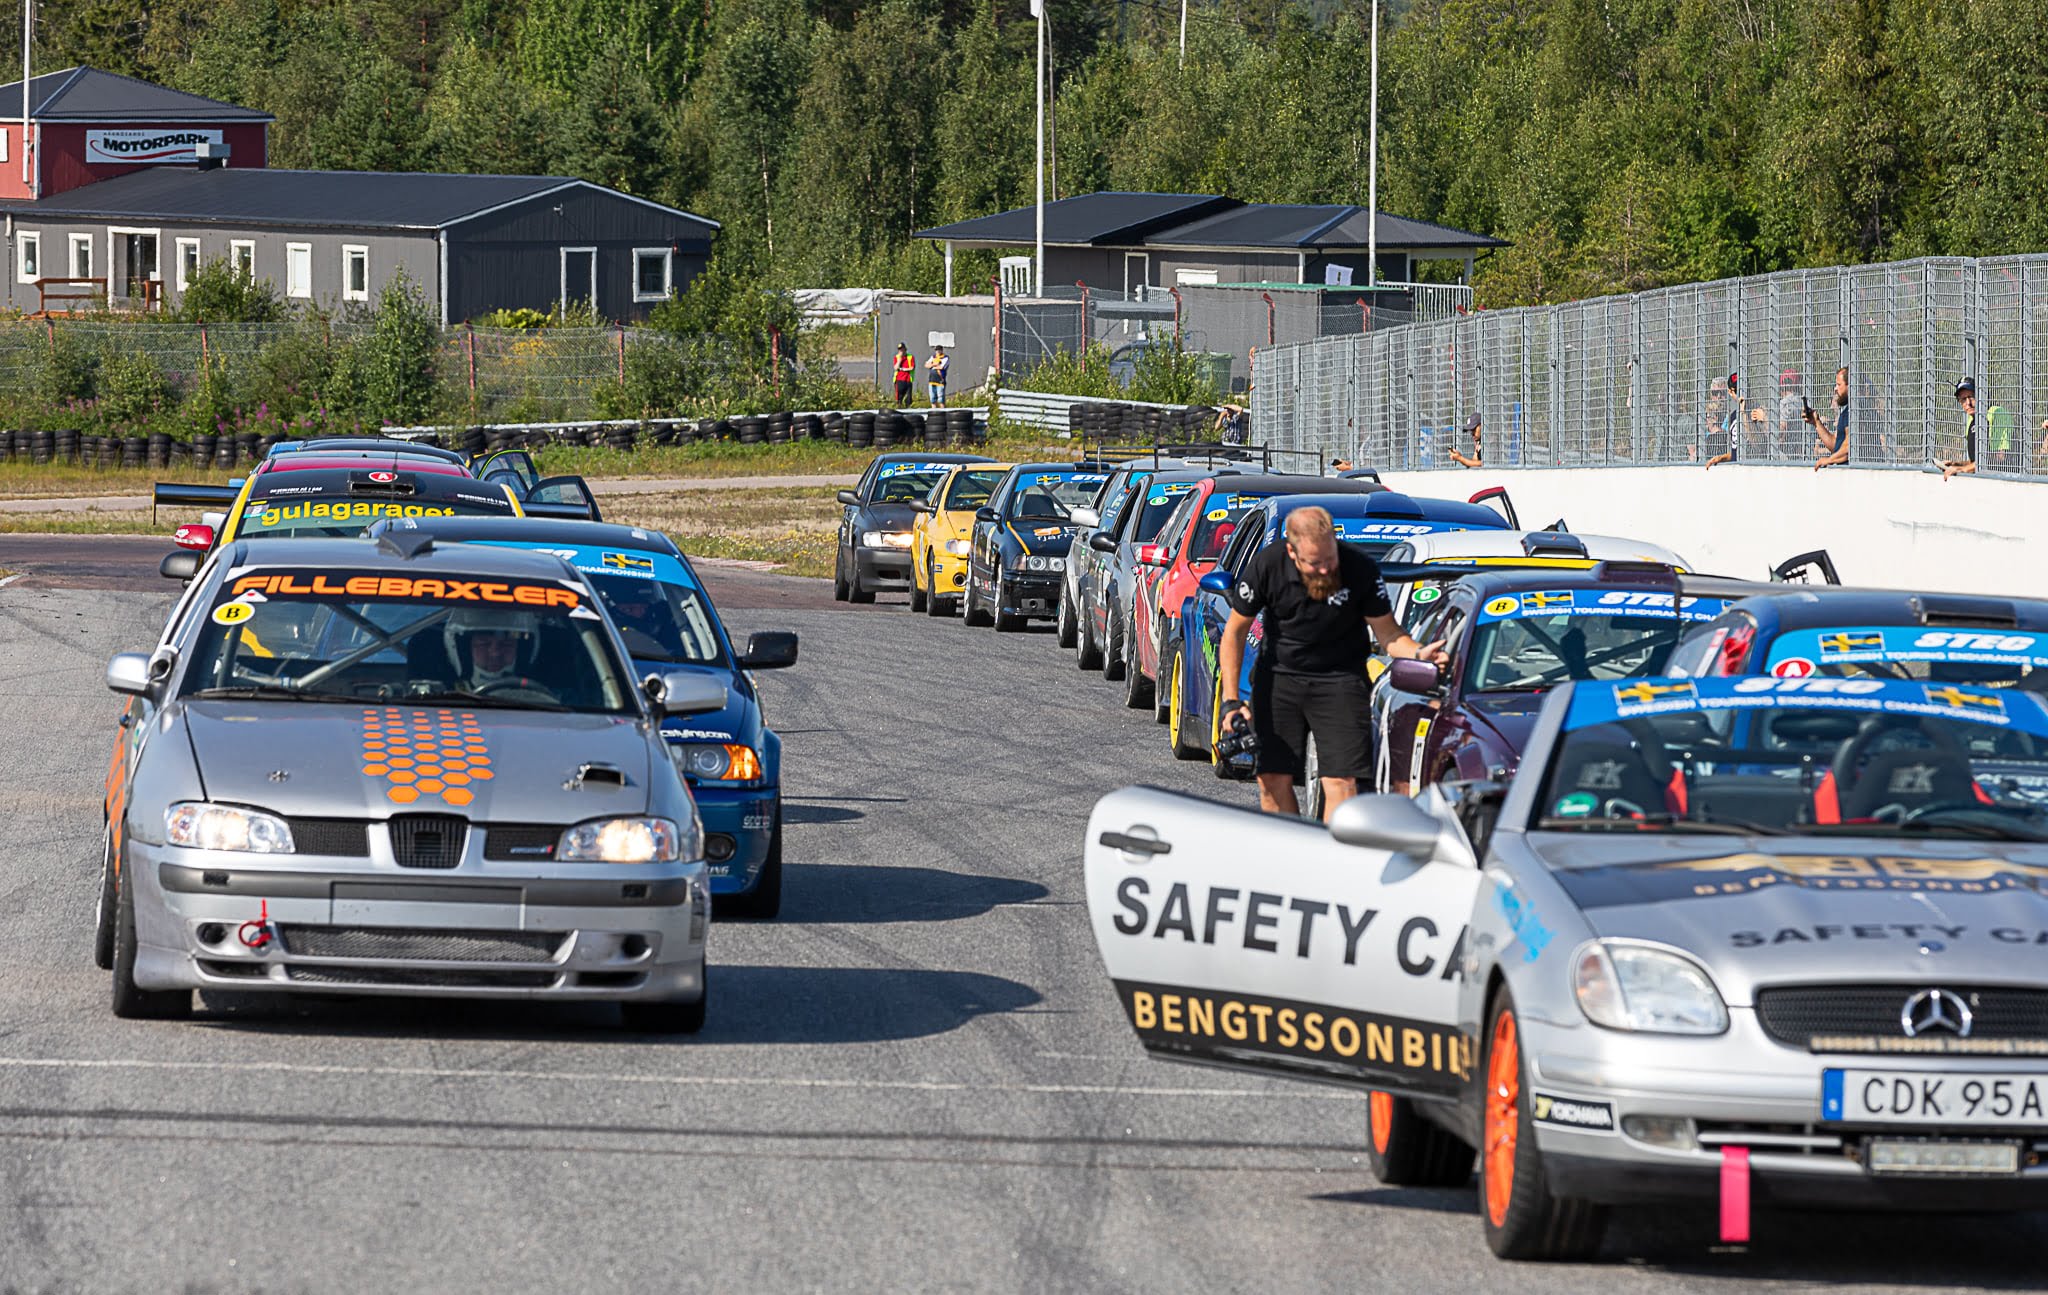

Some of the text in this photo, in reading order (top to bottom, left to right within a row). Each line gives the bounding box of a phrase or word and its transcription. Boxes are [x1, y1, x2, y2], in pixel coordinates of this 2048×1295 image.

[103, 133, 210, 152] MOTORPARK
[261, 500, 455, 527] gulagaraget
[232, 575, 580, 608] FILLEBAXTER
[1521, 607, 1573, 617] SWEDISH
[1574, 607, 1623, 616] TOURING
[1625, 607, 1694, 620] ENDURANCE
[1821, 651, 1884, 663] SWEDISH
[1885, 651, 1946, 661] TOURING
[1947, 651, 2031, 665] ENDURANCE
[1617, 694, 2010, 725] SWEDISH TOURING ENDURANCE CHAMPIONSHIP
[1112, 876, 1380, 967] SAFETY
[1730, 923, 1968, 948] SAFETY
[1863, 1077, 2044, 1118] CDK 95A
